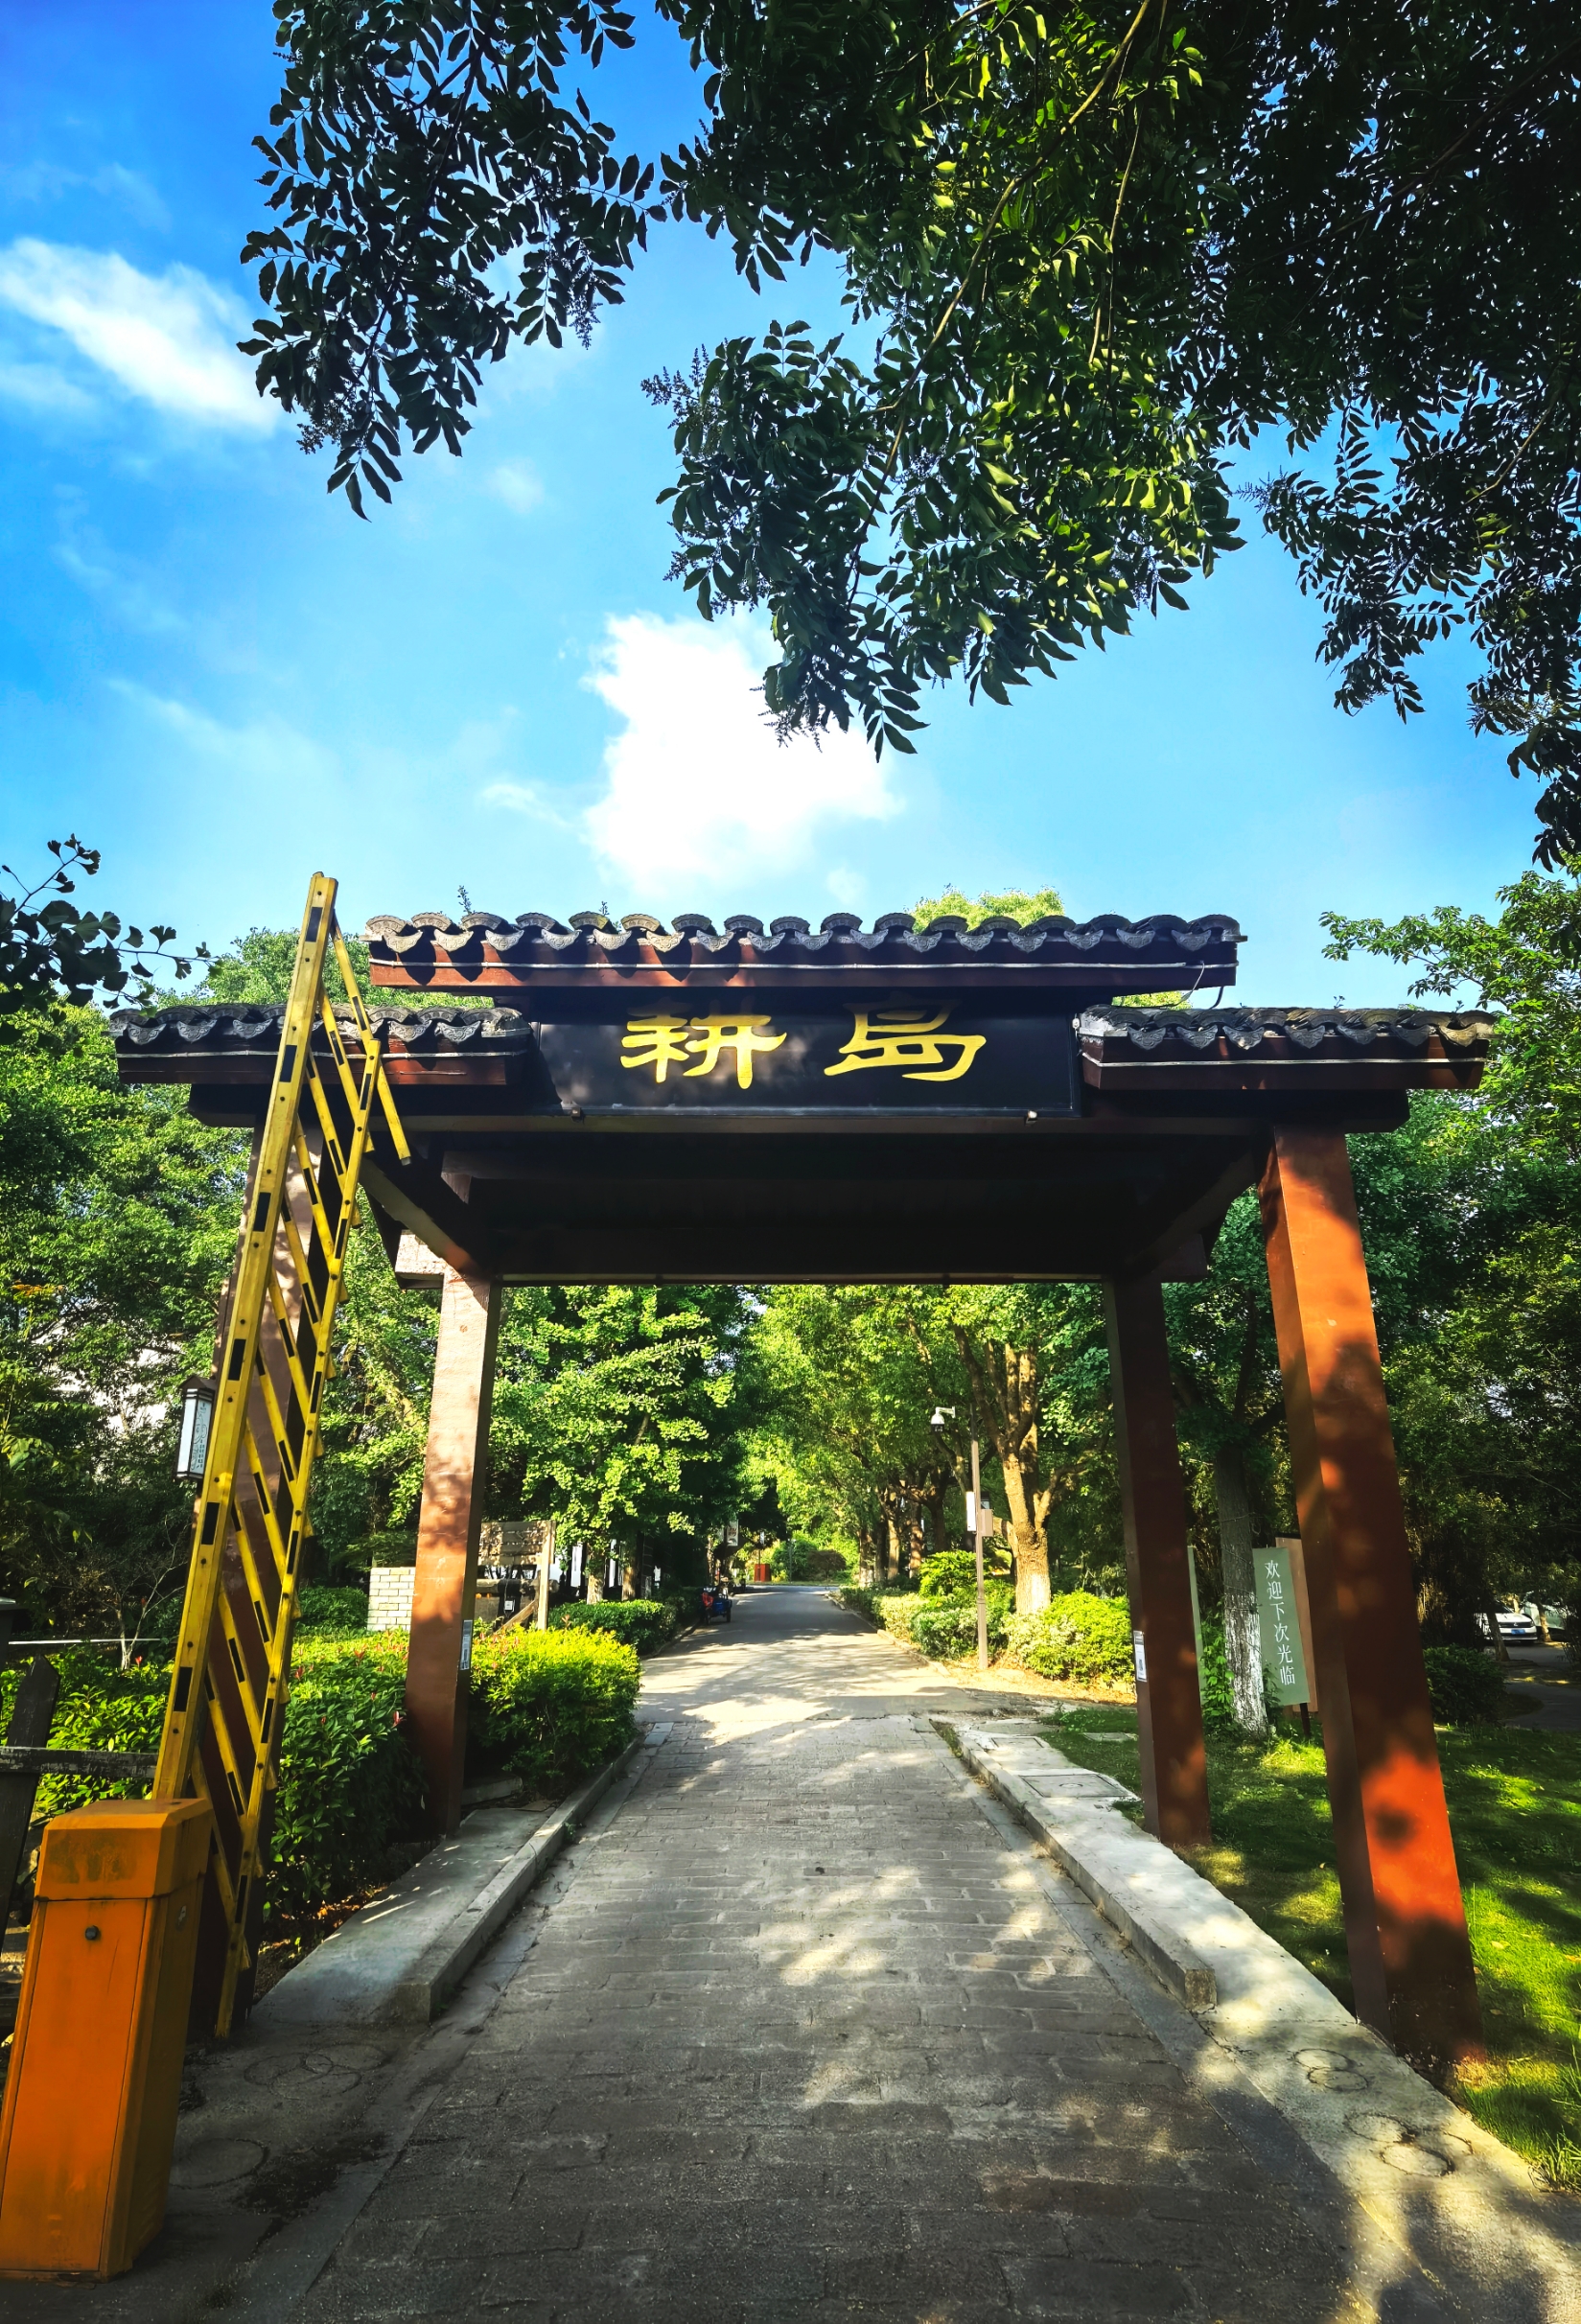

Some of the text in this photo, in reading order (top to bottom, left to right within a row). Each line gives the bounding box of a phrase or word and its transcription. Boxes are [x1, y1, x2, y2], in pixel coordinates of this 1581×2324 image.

[1264, 1559, 1295, 1685] 欢迎下次光临
